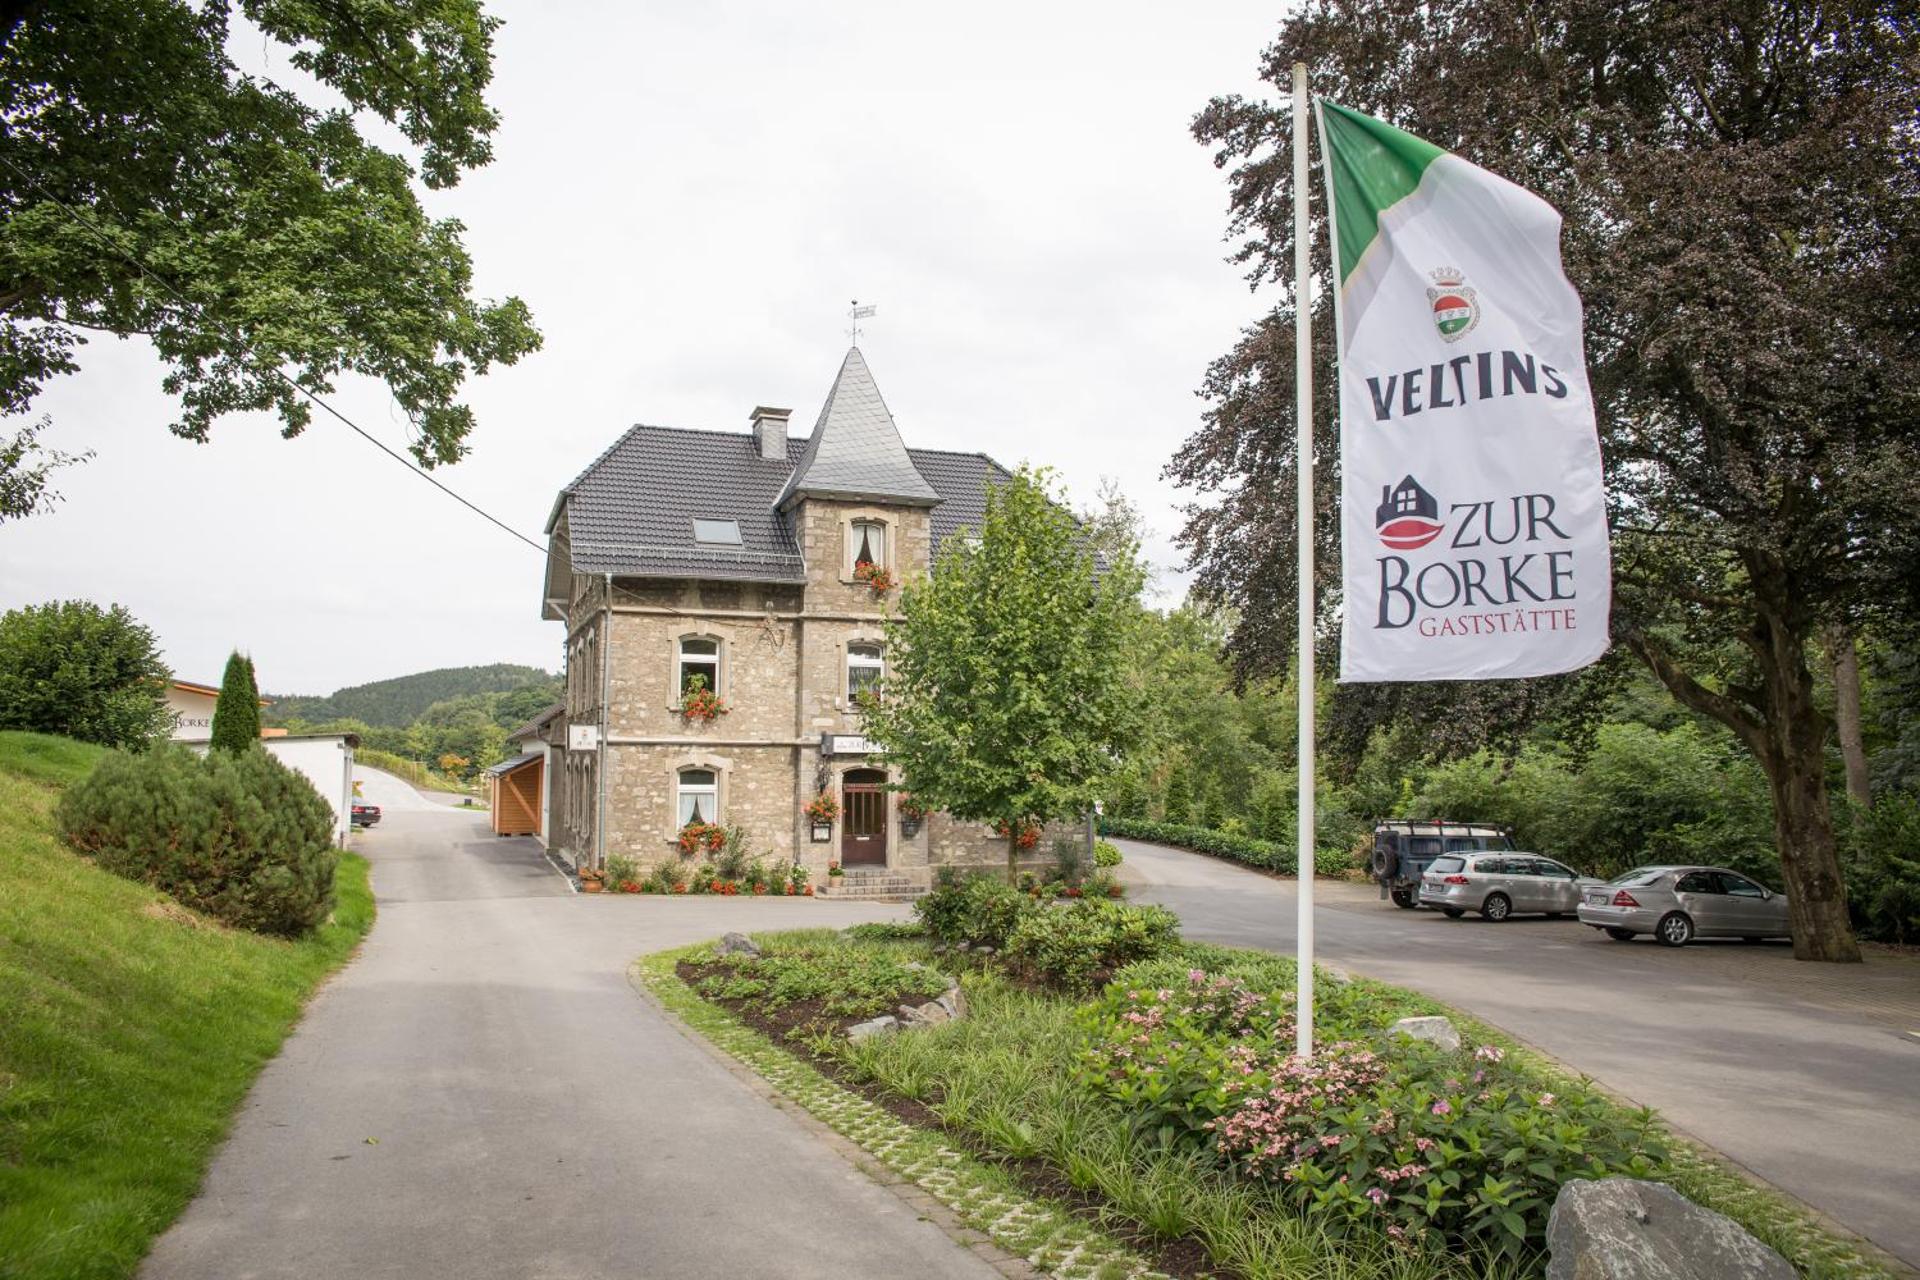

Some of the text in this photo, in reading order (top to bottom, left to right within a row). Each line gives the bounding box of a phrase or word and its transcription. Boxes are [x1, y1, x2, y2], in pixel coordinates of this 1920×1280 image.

[1366, 350, 1568, 421] VELTINS
[1450, 494, 1572, 549] ZUR
[1373, 551, 1577, 629] BORKE
[1419, 608, 1577, 638] GASTSTÄTTE
